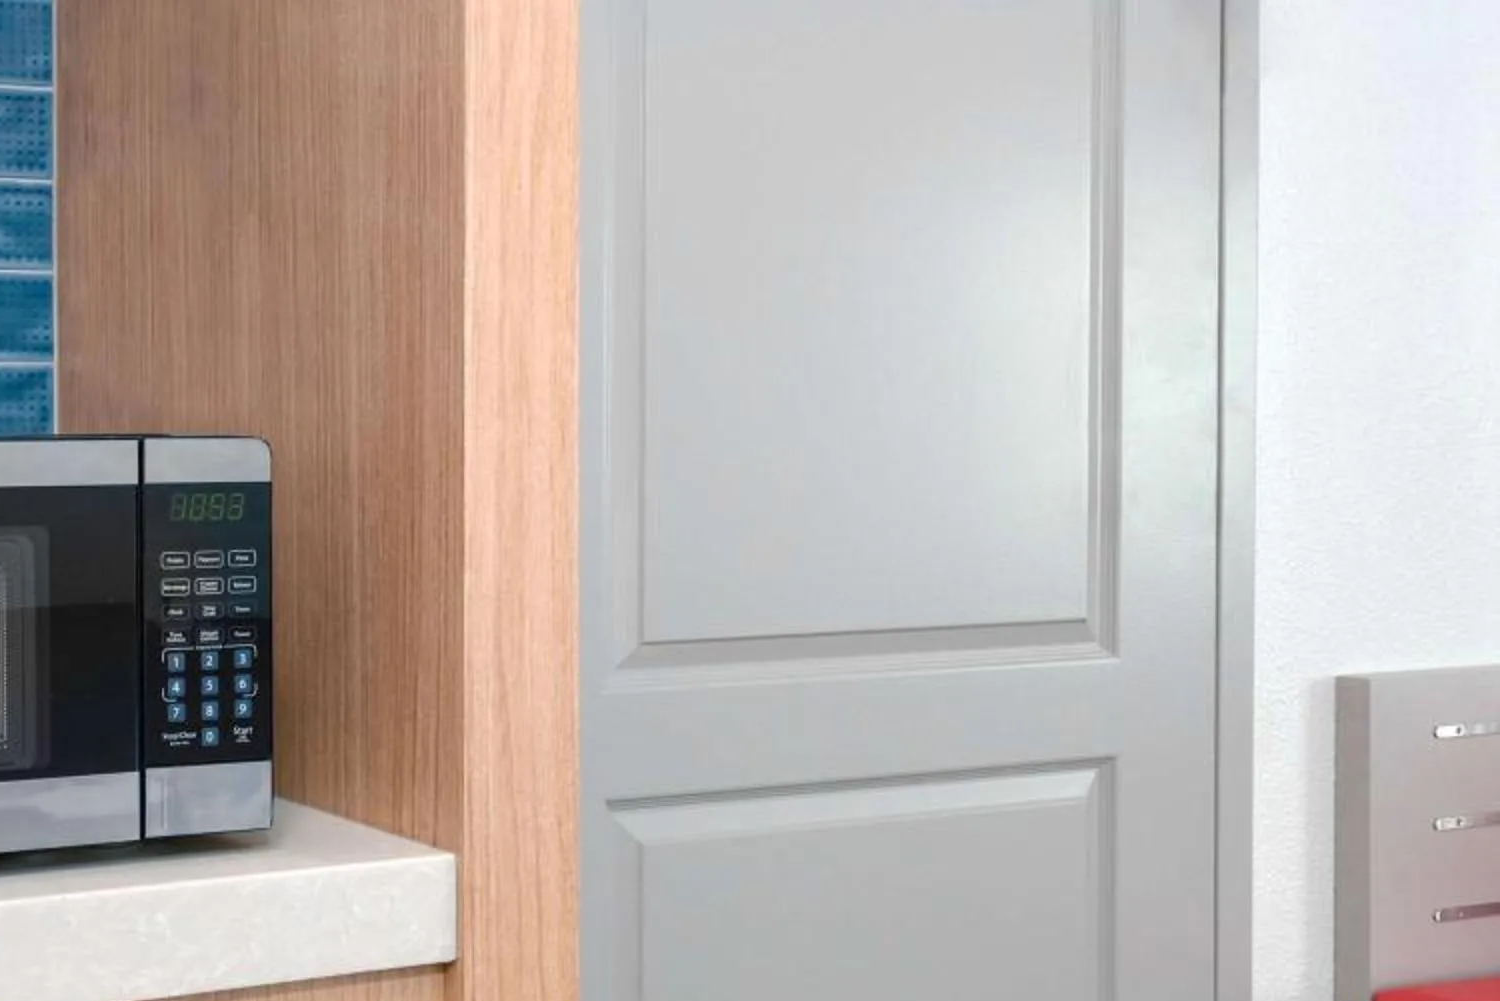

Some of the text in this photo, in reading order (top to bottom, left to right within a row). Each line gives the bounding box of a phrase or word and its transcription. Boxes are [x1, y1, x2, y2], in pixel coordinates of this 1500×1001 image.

[173, 656, 179, 668] 1
[206, 655, 213, 667] 2
[240, 653, 247, 664] 3
[171, 681, 180, 692] 4
[206, 680, 213, 691] 5
[239, 679, 246, 689] 6
[172, 707, 180, 719] 7
[206, 705, 213, 717] 8
[239, 703, 247, 714] 9
[206, 731, 213, 742] 0
